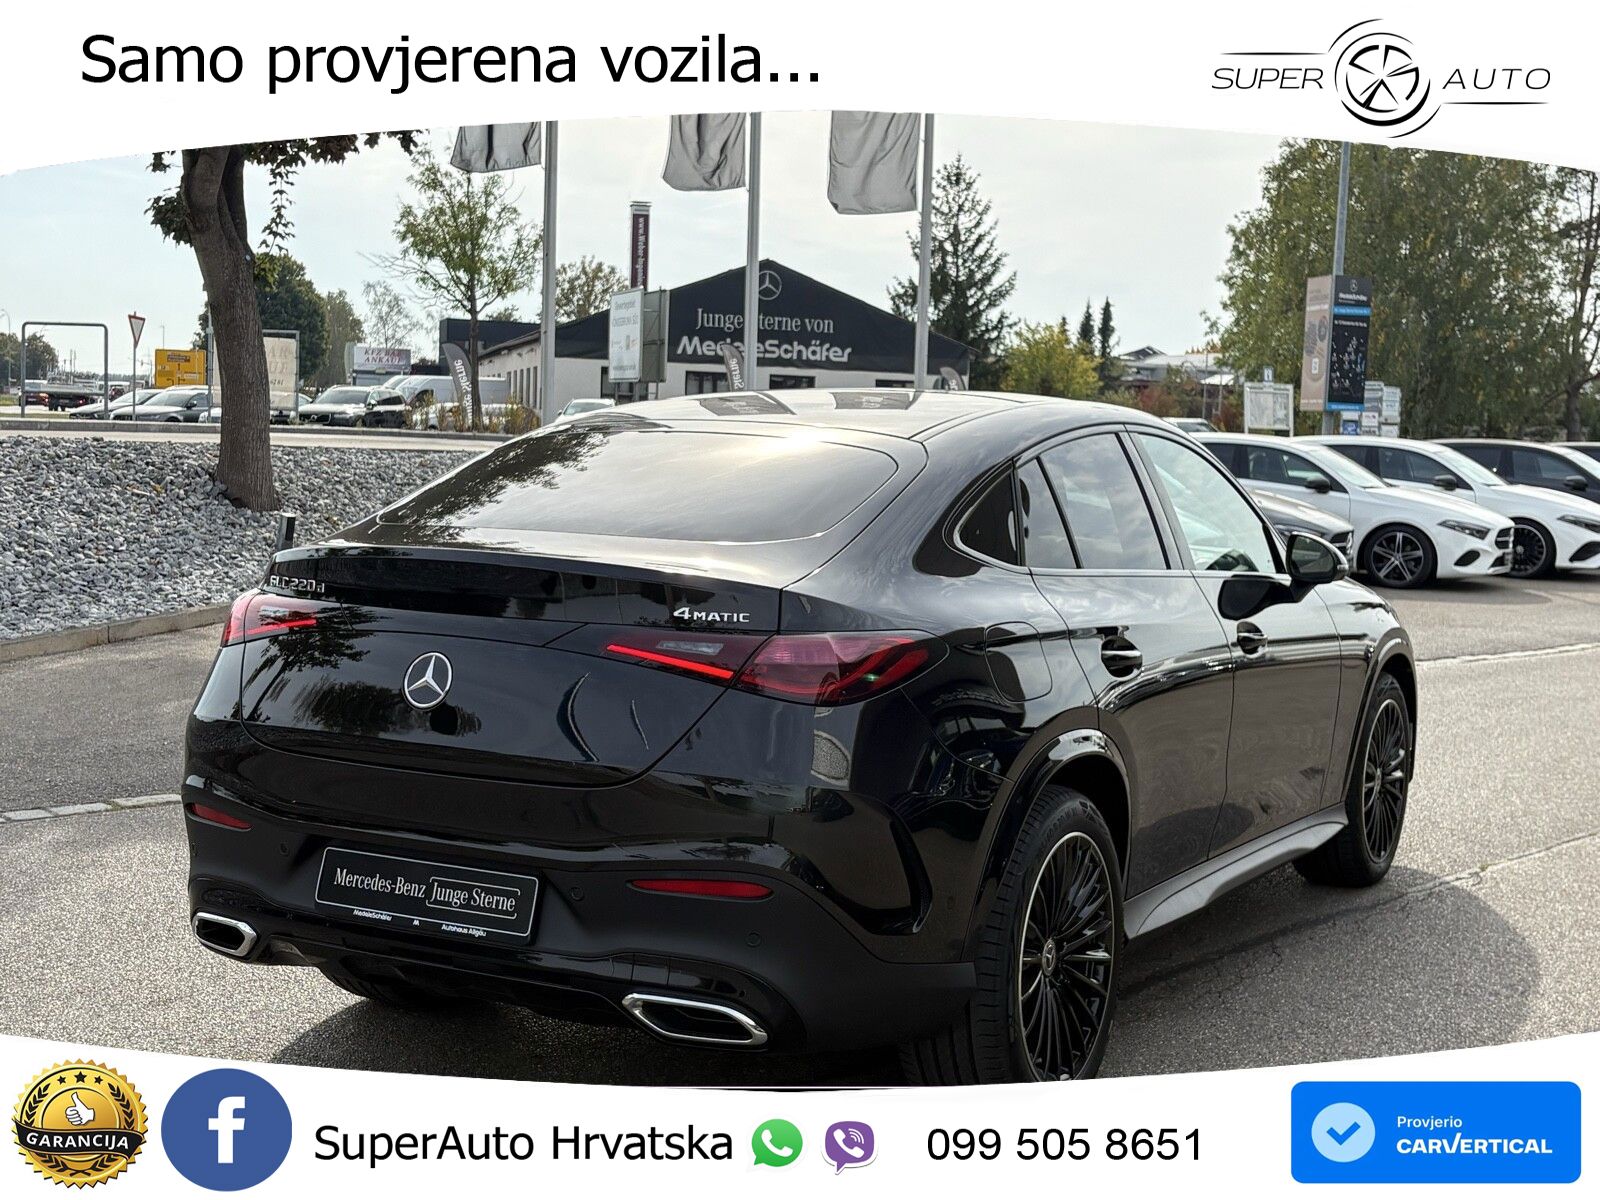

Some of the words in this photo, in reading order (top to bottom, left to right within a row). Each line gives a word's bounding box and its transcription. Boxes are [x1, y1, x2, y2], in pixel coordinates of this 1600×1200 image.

[695, 308, 744, 332] Junge
[758, 312, 801, 332] terne
[804, 318, 834, 334] von
[673, 606, 751, 623] 4MATIC
[333, 868, 426, 898] Mercedes-Benz
[431, 882, 469, 907] Junge
[470, 887, 516, 911] Sterne
